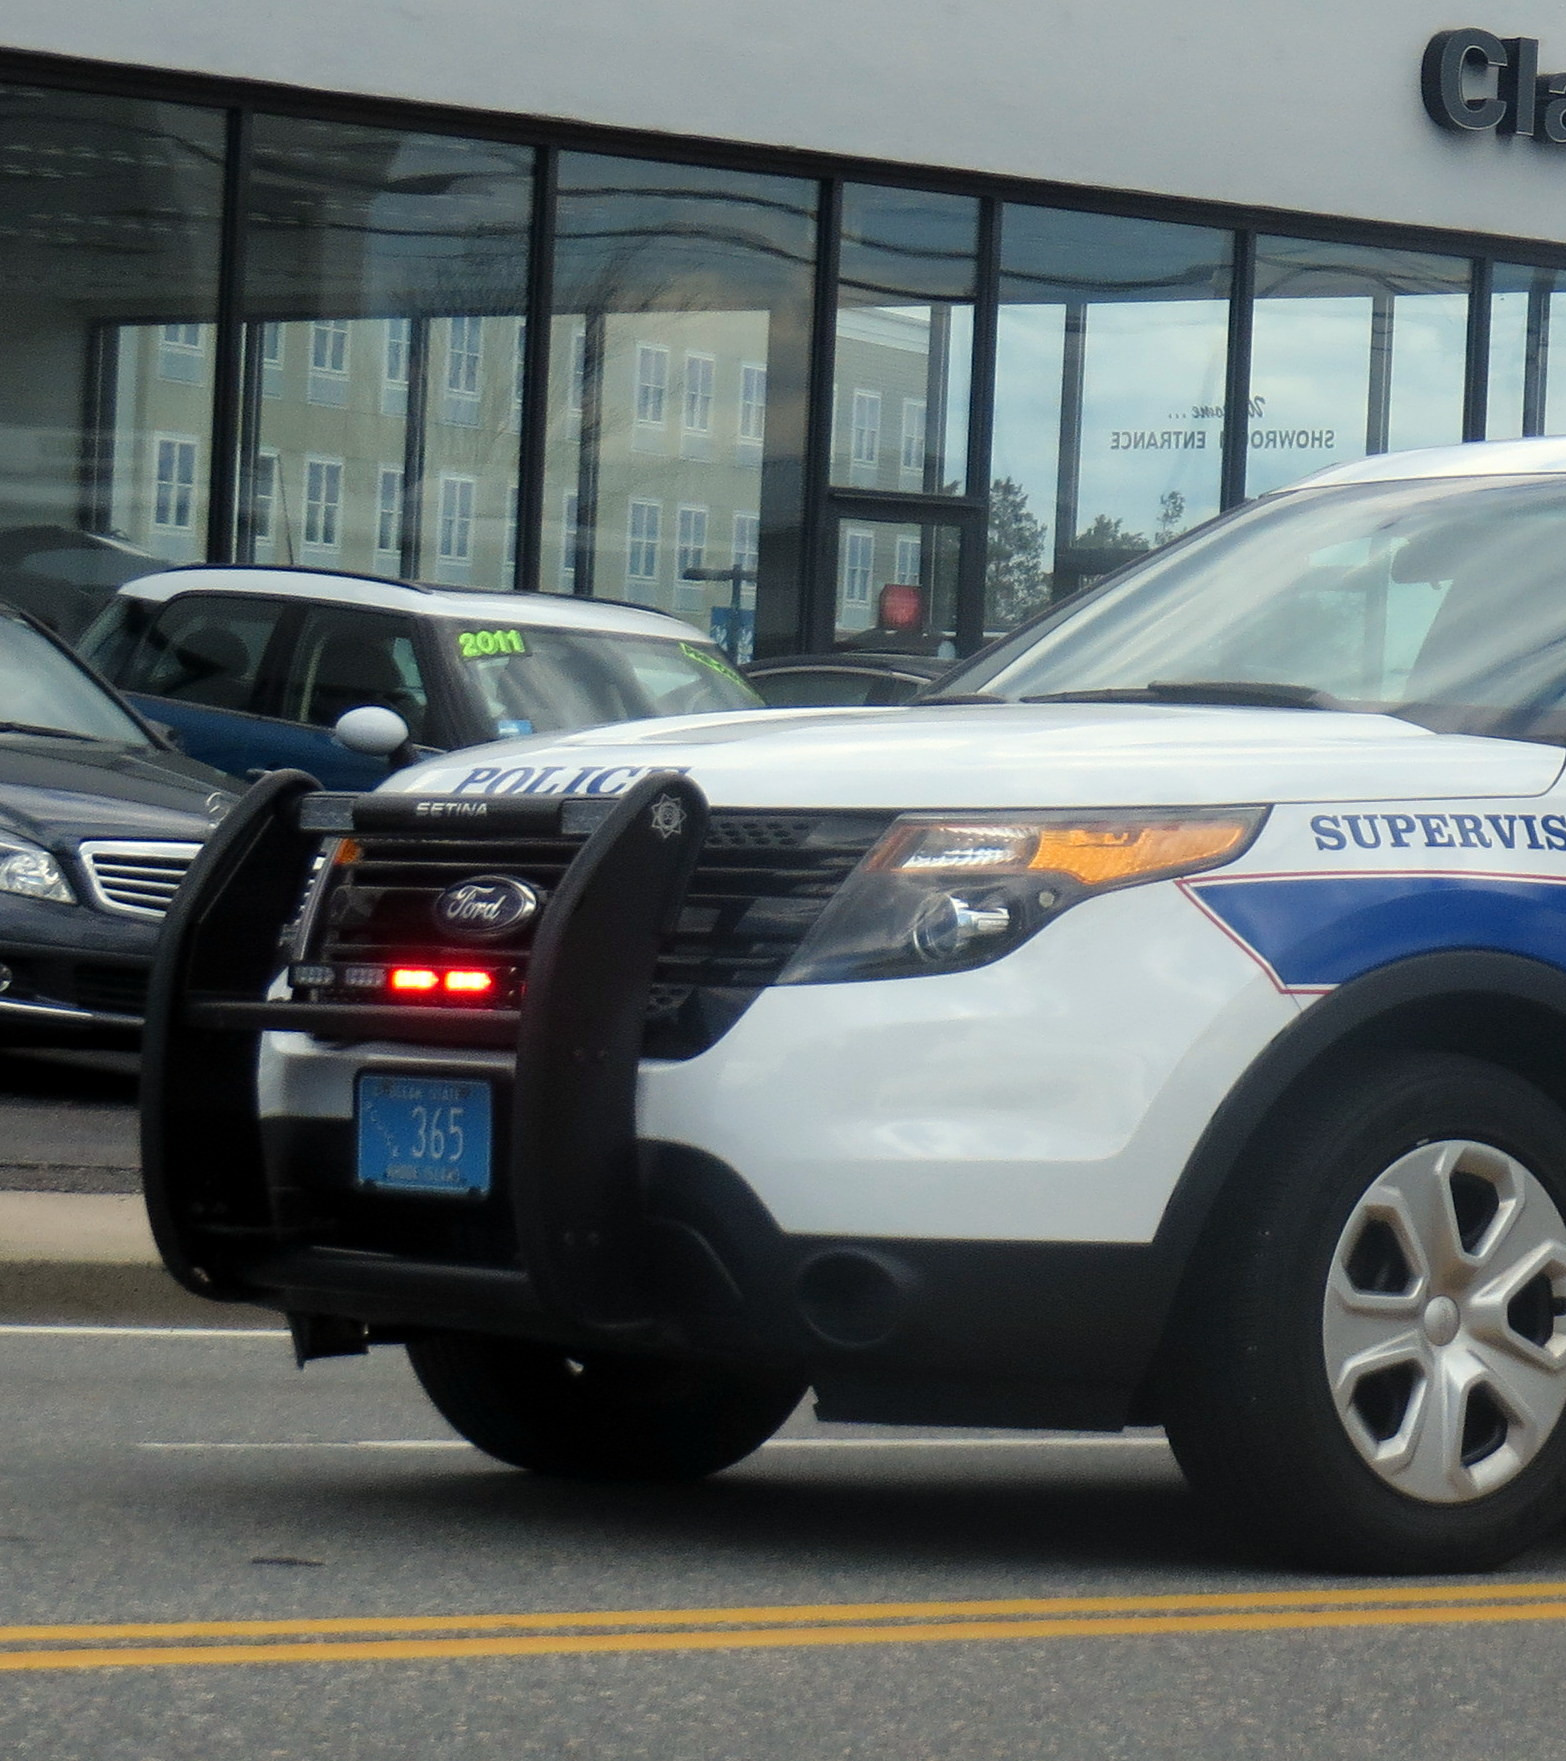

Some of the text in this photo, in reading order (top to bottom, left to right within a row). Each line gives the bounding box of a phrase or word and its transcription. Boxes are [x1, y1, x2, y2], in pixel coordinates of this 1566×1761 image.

[459, 629, 525, 657] 2011
[452, 766, 691, 794] POLIC
[416, 801, 488, 817] SETINA
[446, 884, 507, 921] Ford
[410, 1105, 464, 1163] 365
